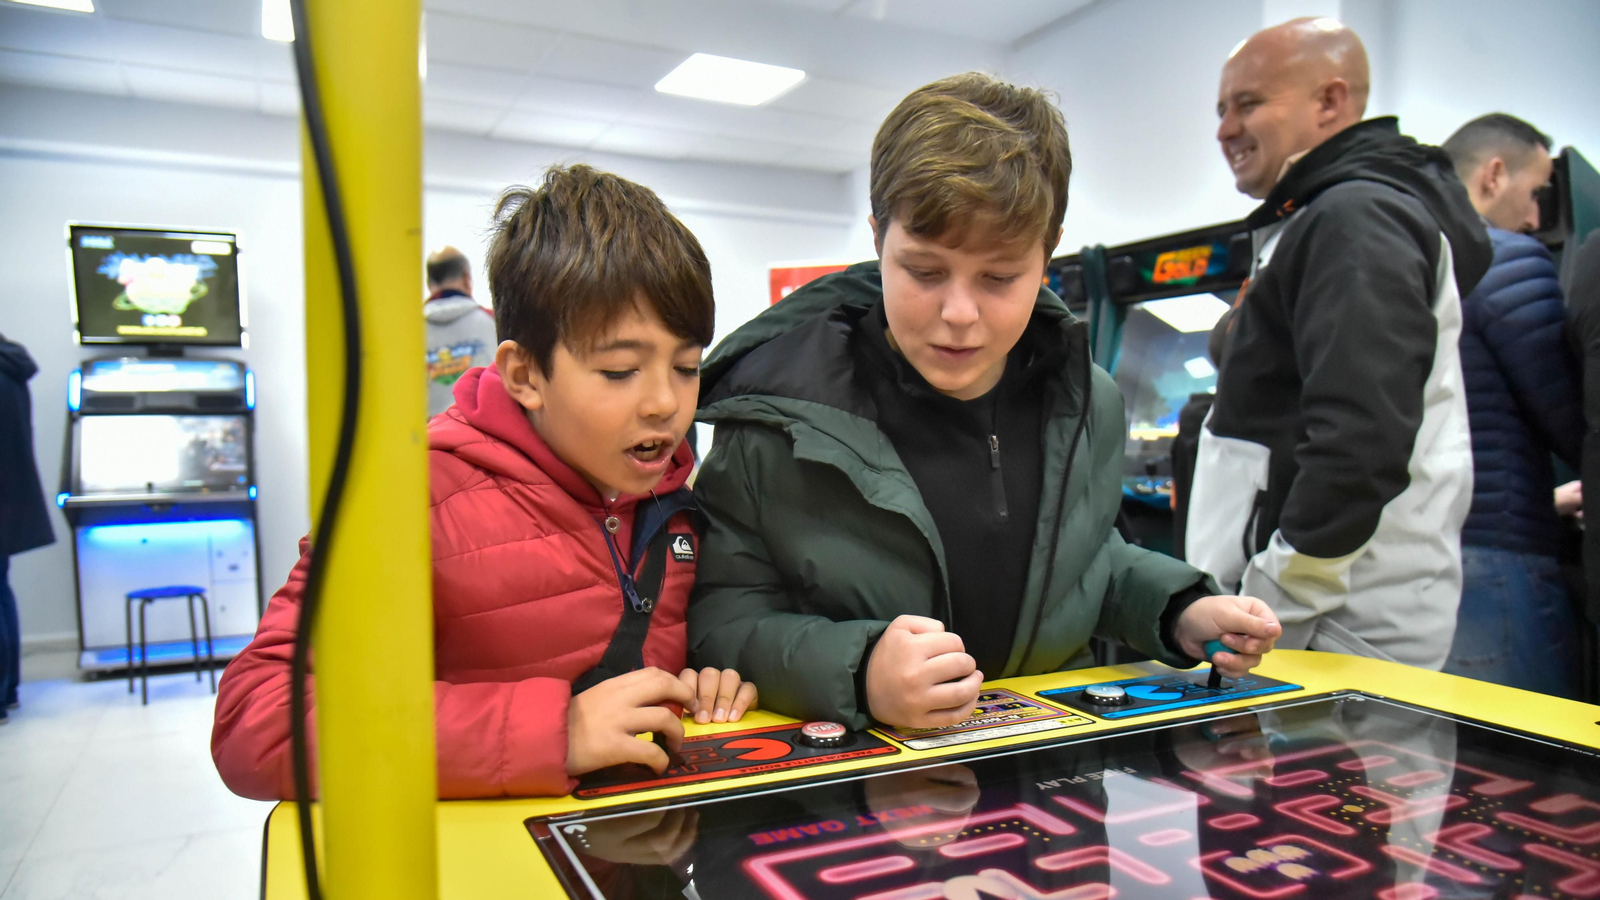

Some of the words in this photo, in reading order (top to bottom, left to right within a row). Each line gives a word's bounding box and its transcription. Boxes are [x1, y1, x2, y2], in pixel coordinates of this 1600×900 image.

[809, 723, 840, 732] START
[738, 764, 782, 774] ROYALE
[785, 757, 824, 767] BATTLE
[1083, 766, 1138, 782] FREE
[1036, 775, 1088, 791] PLAY
[856, 805, 935, 827] NEXT
[748, 820, 848, 846] GAME
